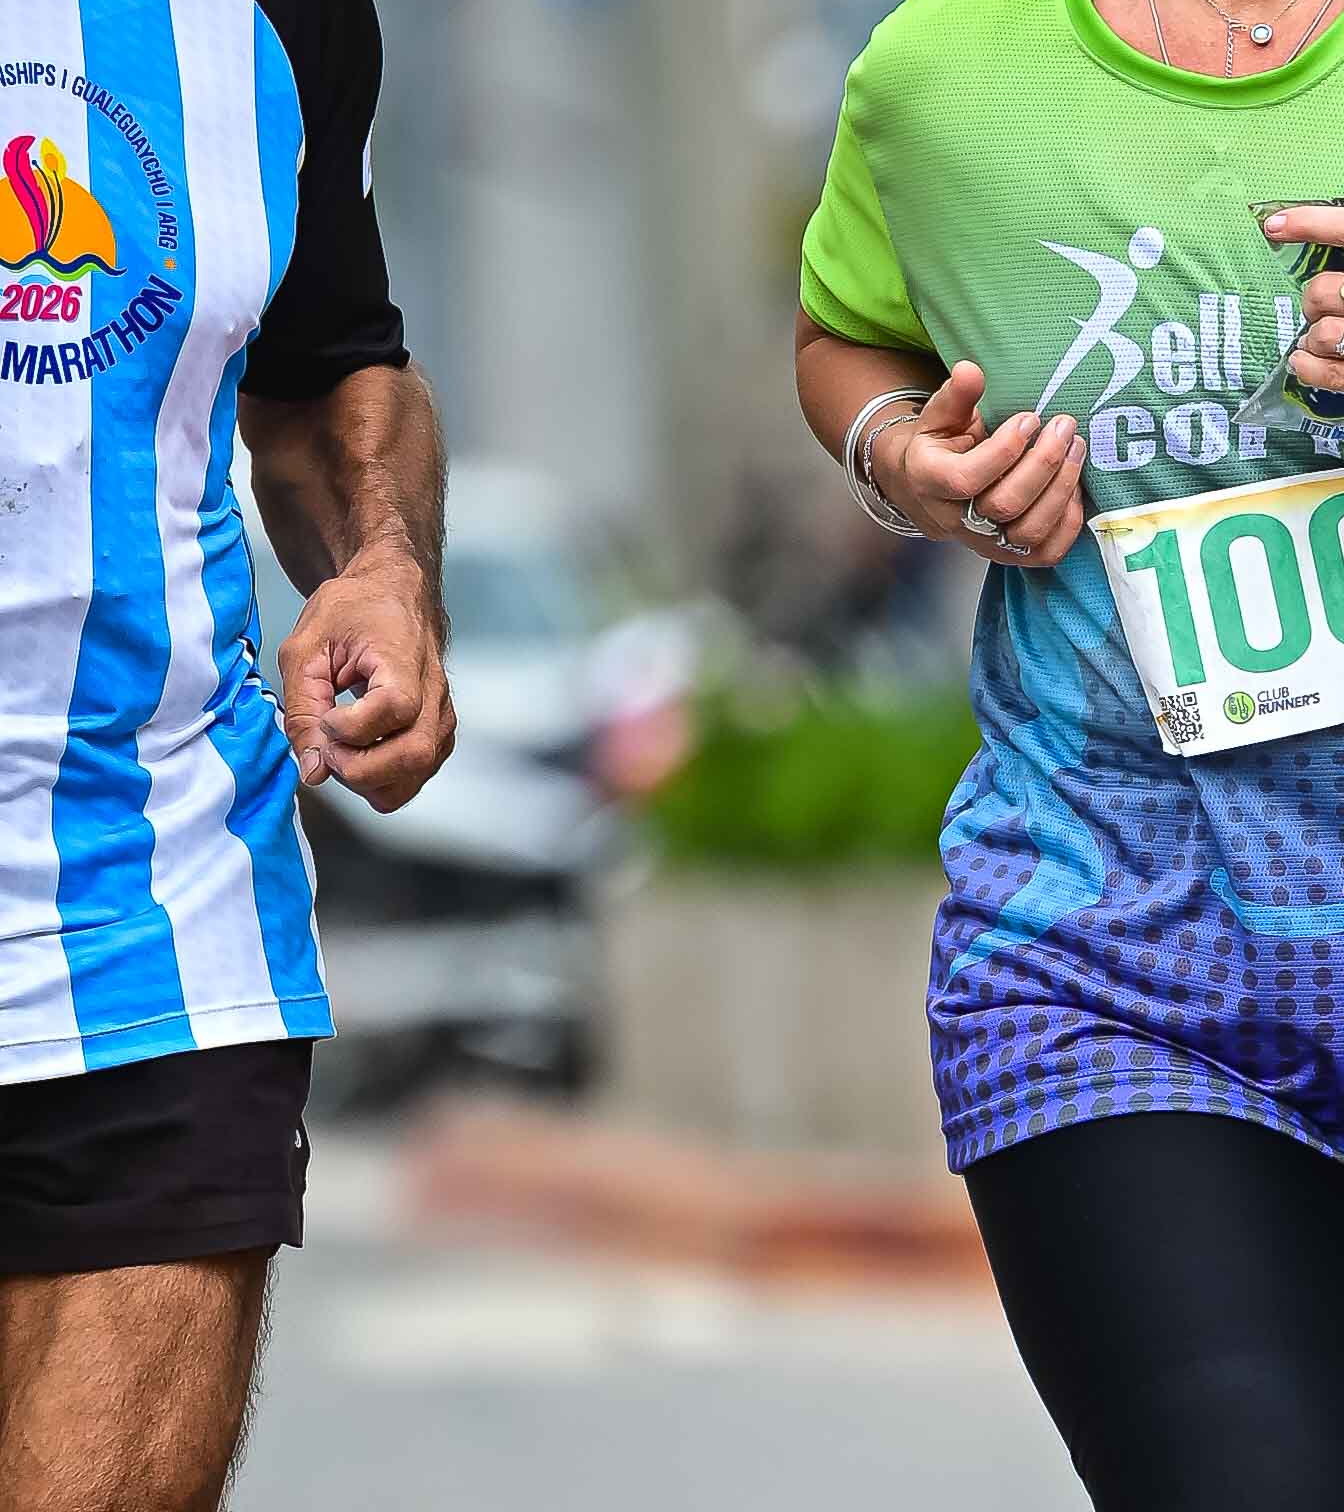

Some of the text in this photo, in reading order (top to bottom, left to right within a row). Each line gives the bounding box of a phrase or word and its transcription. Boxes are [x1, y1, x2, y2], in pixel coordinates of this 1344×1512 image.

[72, 76, 174, 196] GUALEGUAYCHÚ
[158, 212, 178, 249] ARG
[0, 284, 82, 321] 2026
[1, 275, 183, 384] MARATHON
[1257, 687, 1290, 703] CLUB
[1258, 692, 1321, 715] RUNNER'S
